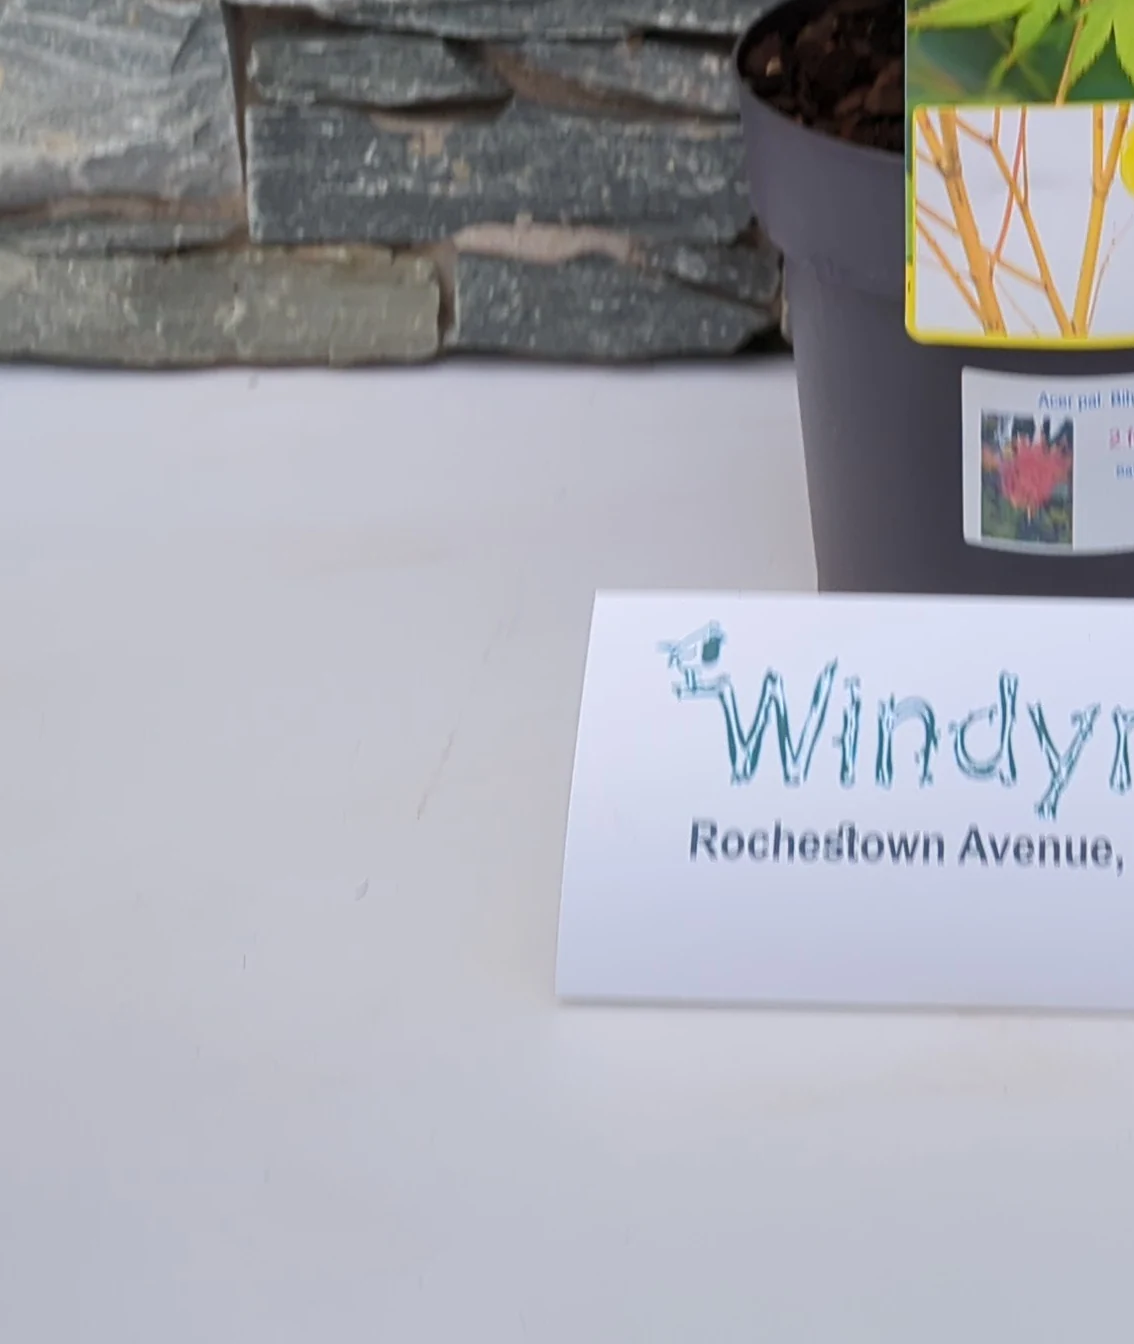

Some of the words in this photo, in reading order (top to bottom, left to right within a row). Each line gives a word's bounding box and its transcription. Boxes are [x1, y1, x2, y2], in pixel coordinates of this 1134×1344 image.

[1109, 426, 1121, 451] 2
[687, 819, 947, 867] Rochestown
[957, 826, 1125, 876] Avenue,
